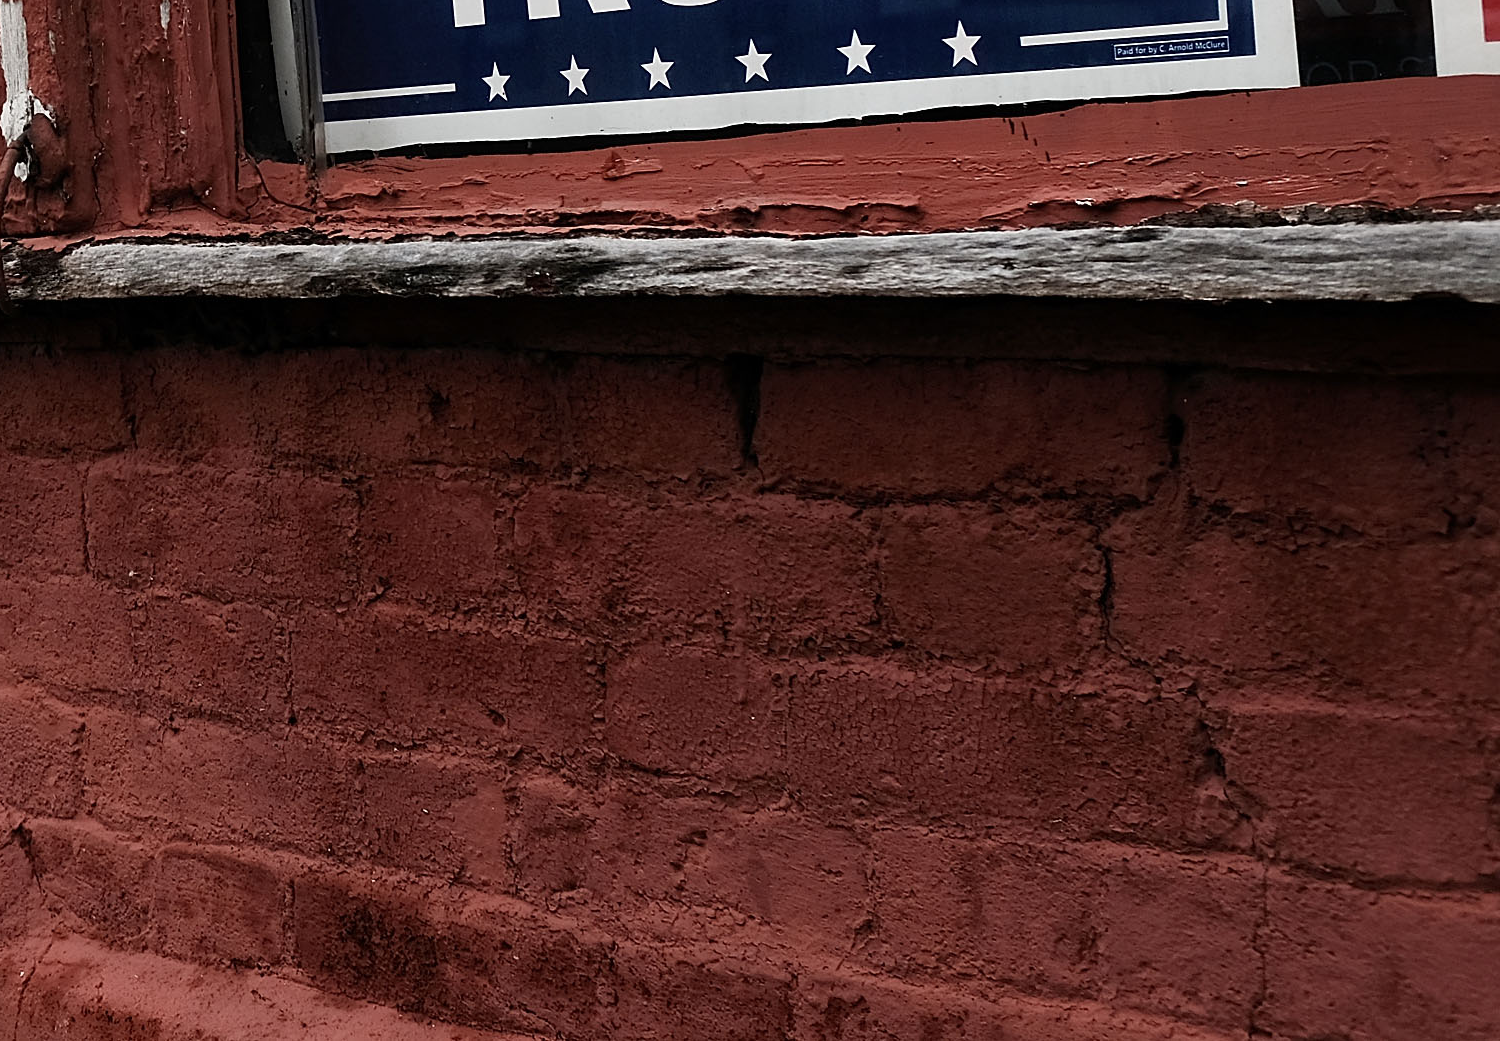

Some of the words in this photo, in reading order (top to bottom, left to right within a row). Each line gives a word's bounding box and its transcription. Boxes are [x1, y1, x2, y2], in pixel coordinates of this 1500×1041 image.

[1117, 47, 1134, 56] Paid
[1135, 46, 1146, 54] for
[1148, 45, 1158, 55] by
[1168, 43, 1194, 52] Arnold
[1195, 41, 1226, 50] McClure
